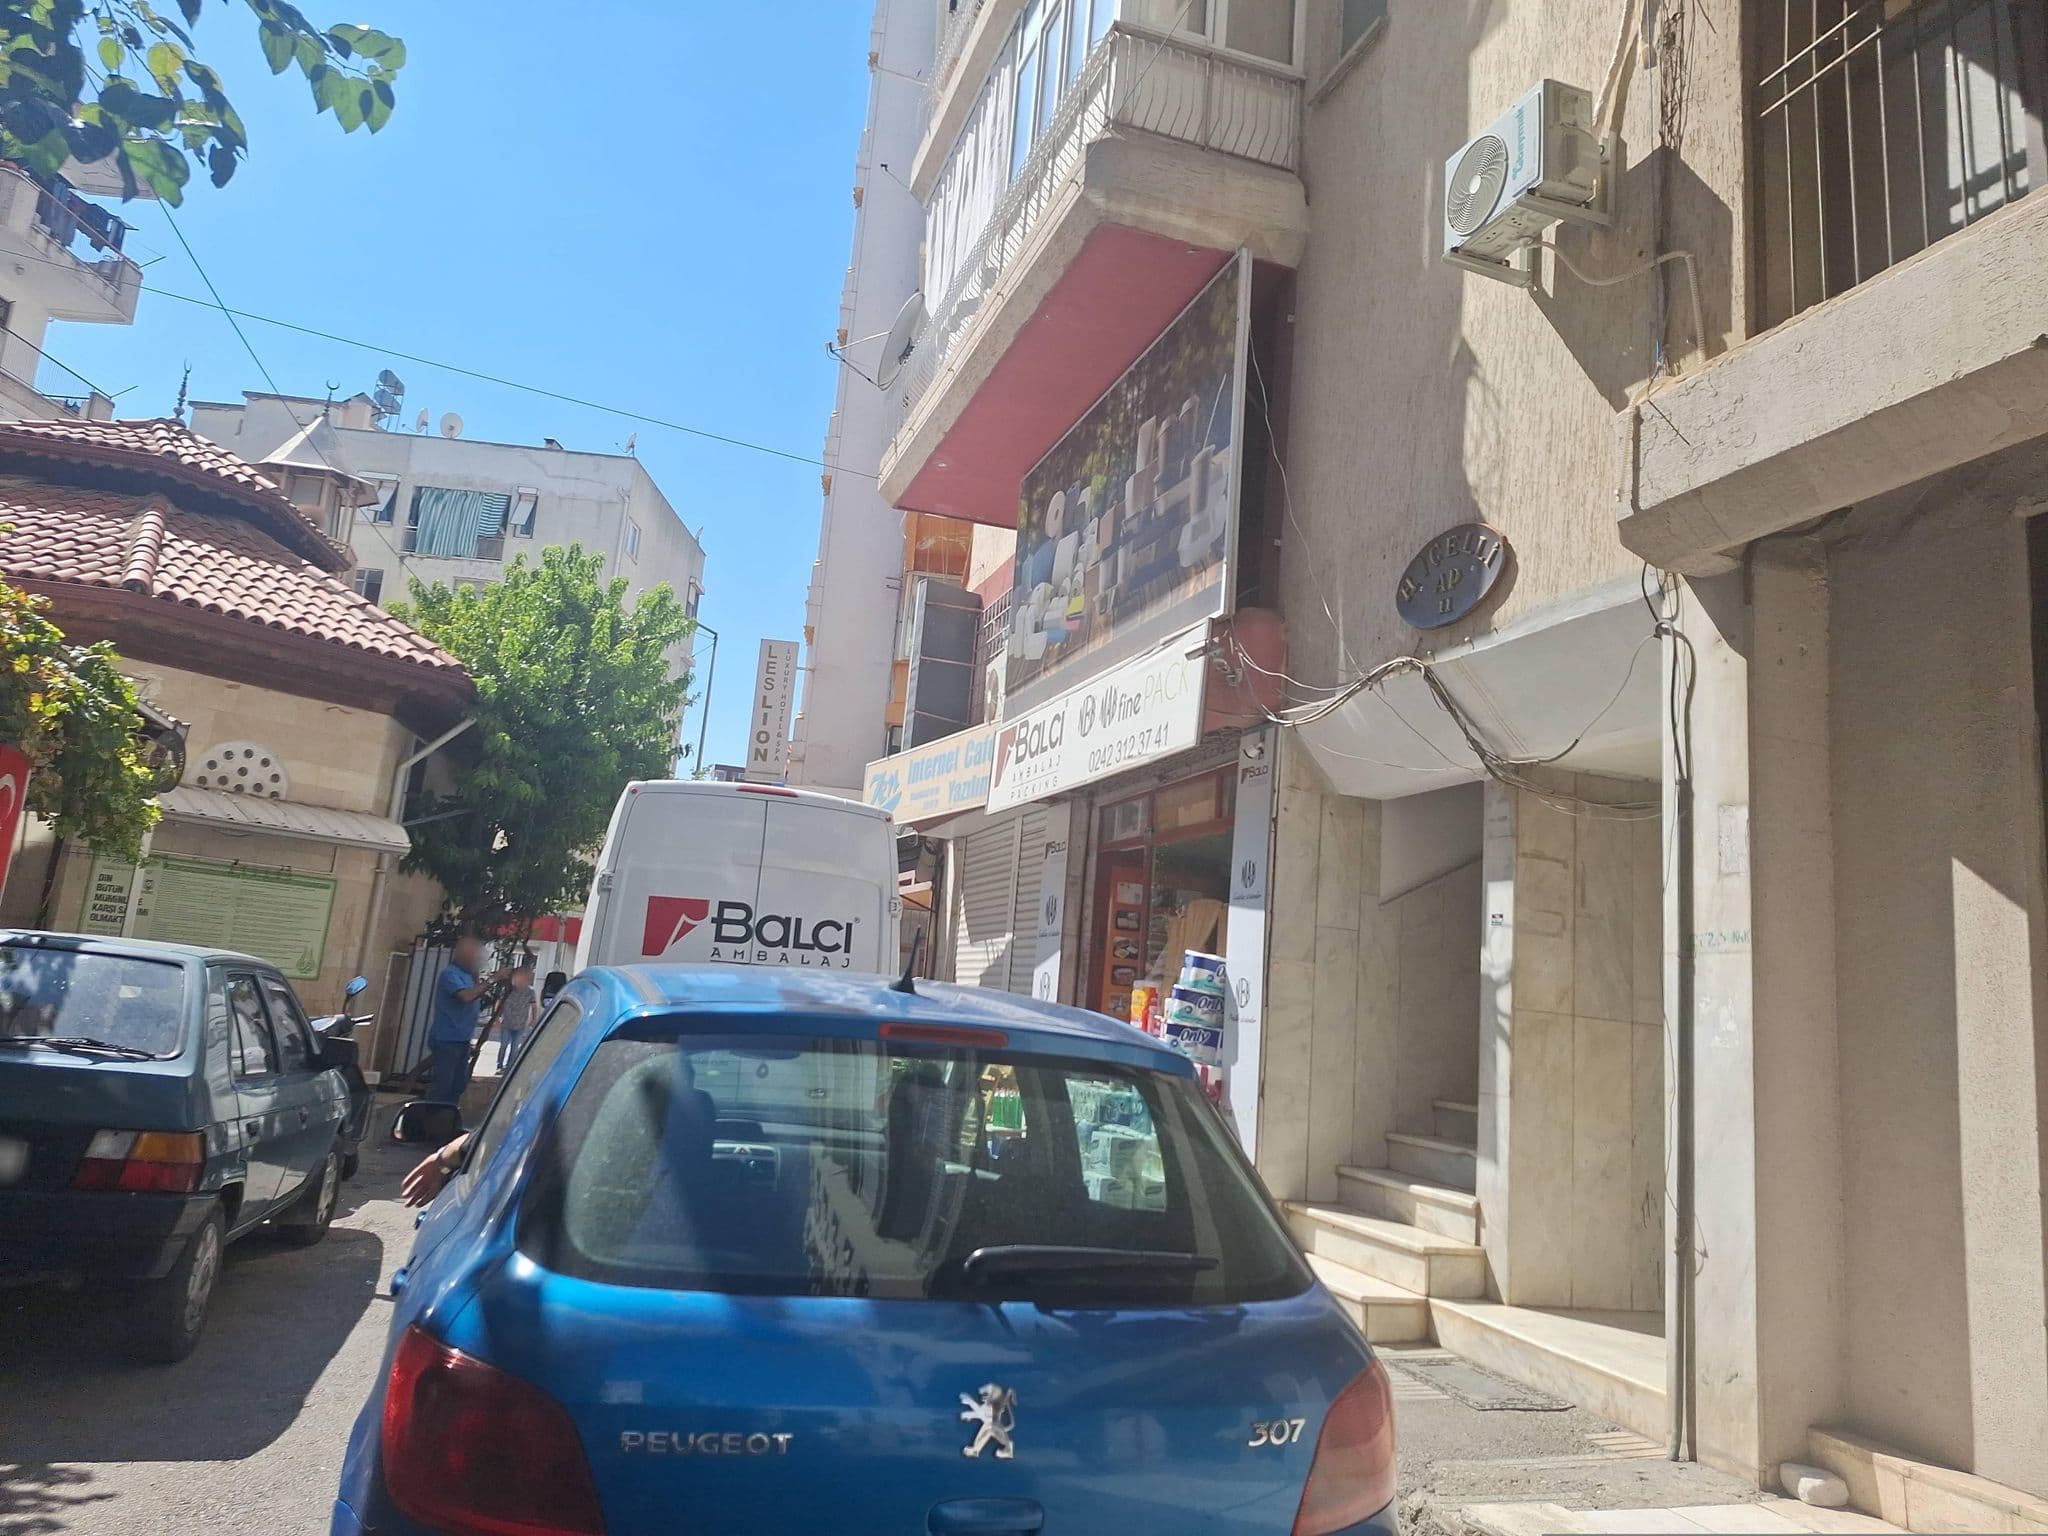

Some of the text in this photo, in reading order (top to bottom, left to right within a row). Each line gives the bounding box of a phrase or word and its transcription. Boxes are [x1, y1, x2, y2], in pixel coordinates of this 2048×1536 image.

[1088, 721, 1169, 774] 0242 312 37 41
[711, 947, 851, 968] AMBALAJ
[1180, 1028, 1211, 1045] Only
[620, 1431, 795, 1455] PEUGEOT
[1248, 1418, 1306, 1447] 307
